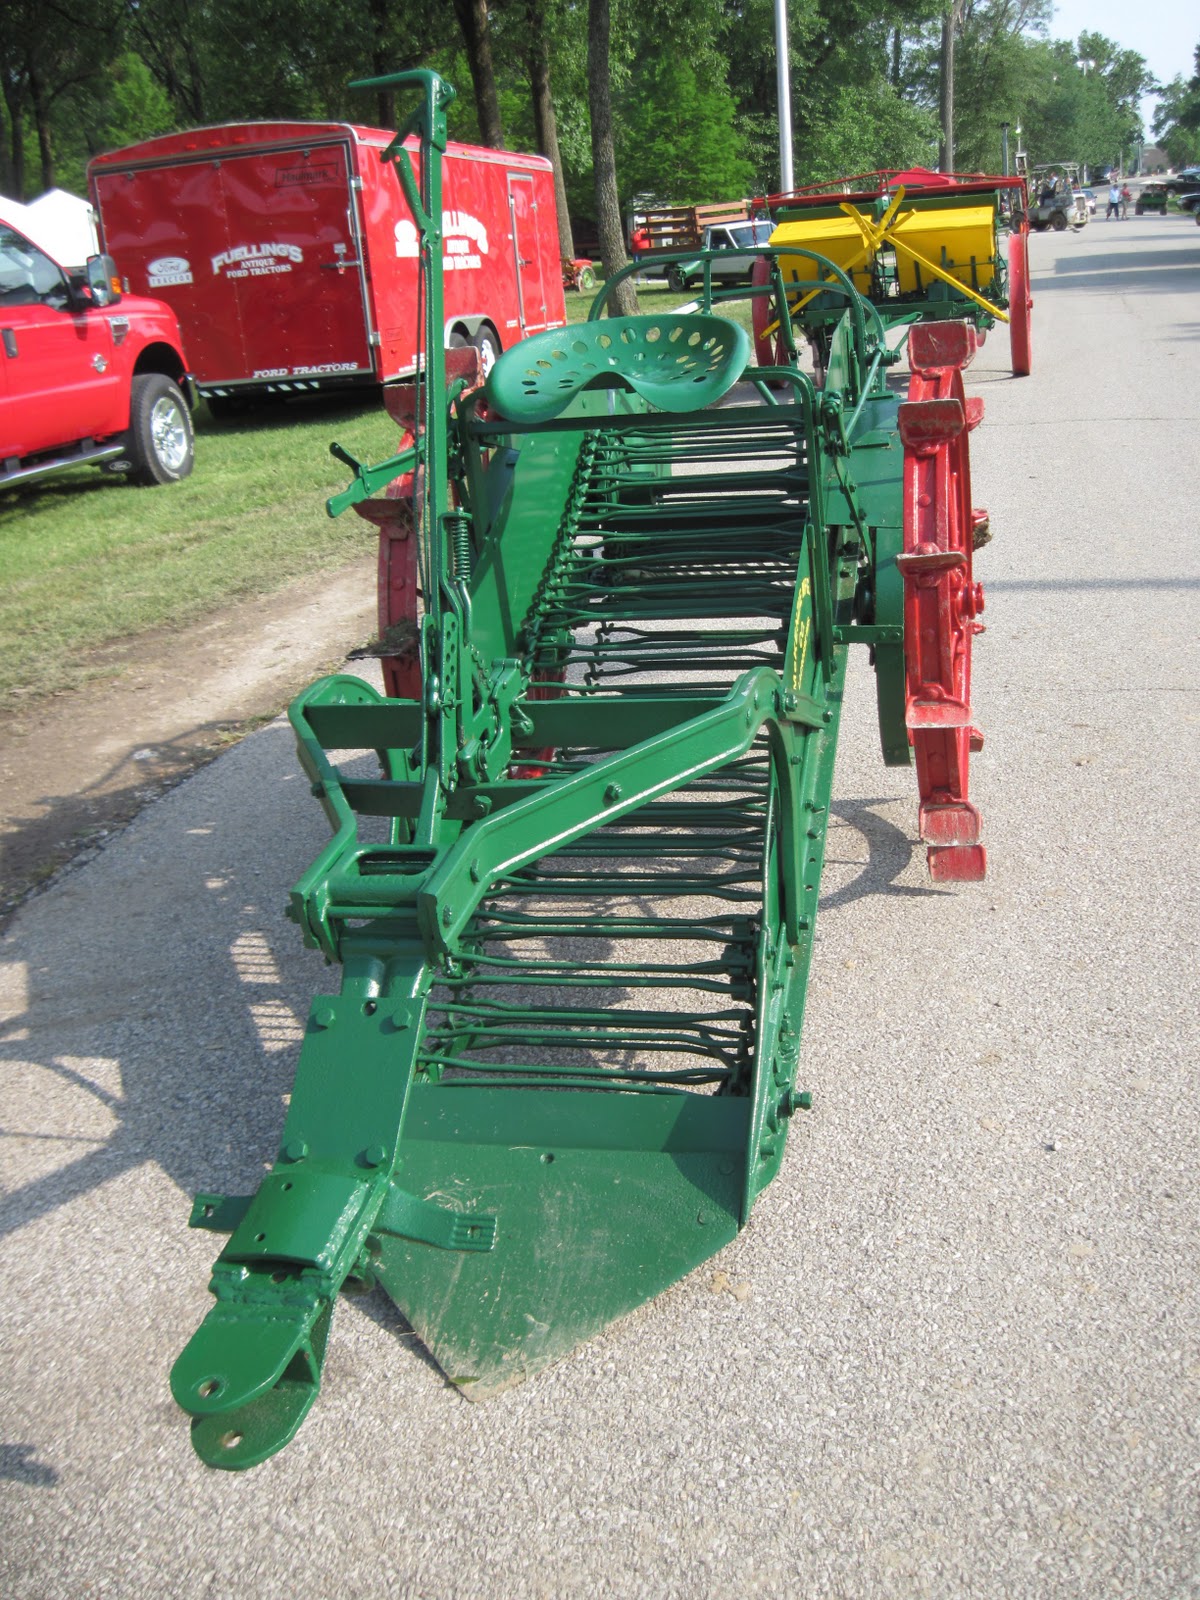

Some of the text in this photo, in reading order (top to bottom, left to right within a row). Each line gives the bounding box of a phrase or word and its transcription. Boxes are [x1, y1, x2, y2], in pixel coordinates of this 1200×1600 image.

[211, 243, 304, 275] FUELLING'S
[240, 257, 276, 269] ANTIQUE
[226, 264, 292, 279] FORD TRACTORS
[151, 275, 191, 285] TRACTOR
[253, 362, 358, 378] FORD TRACTORS
